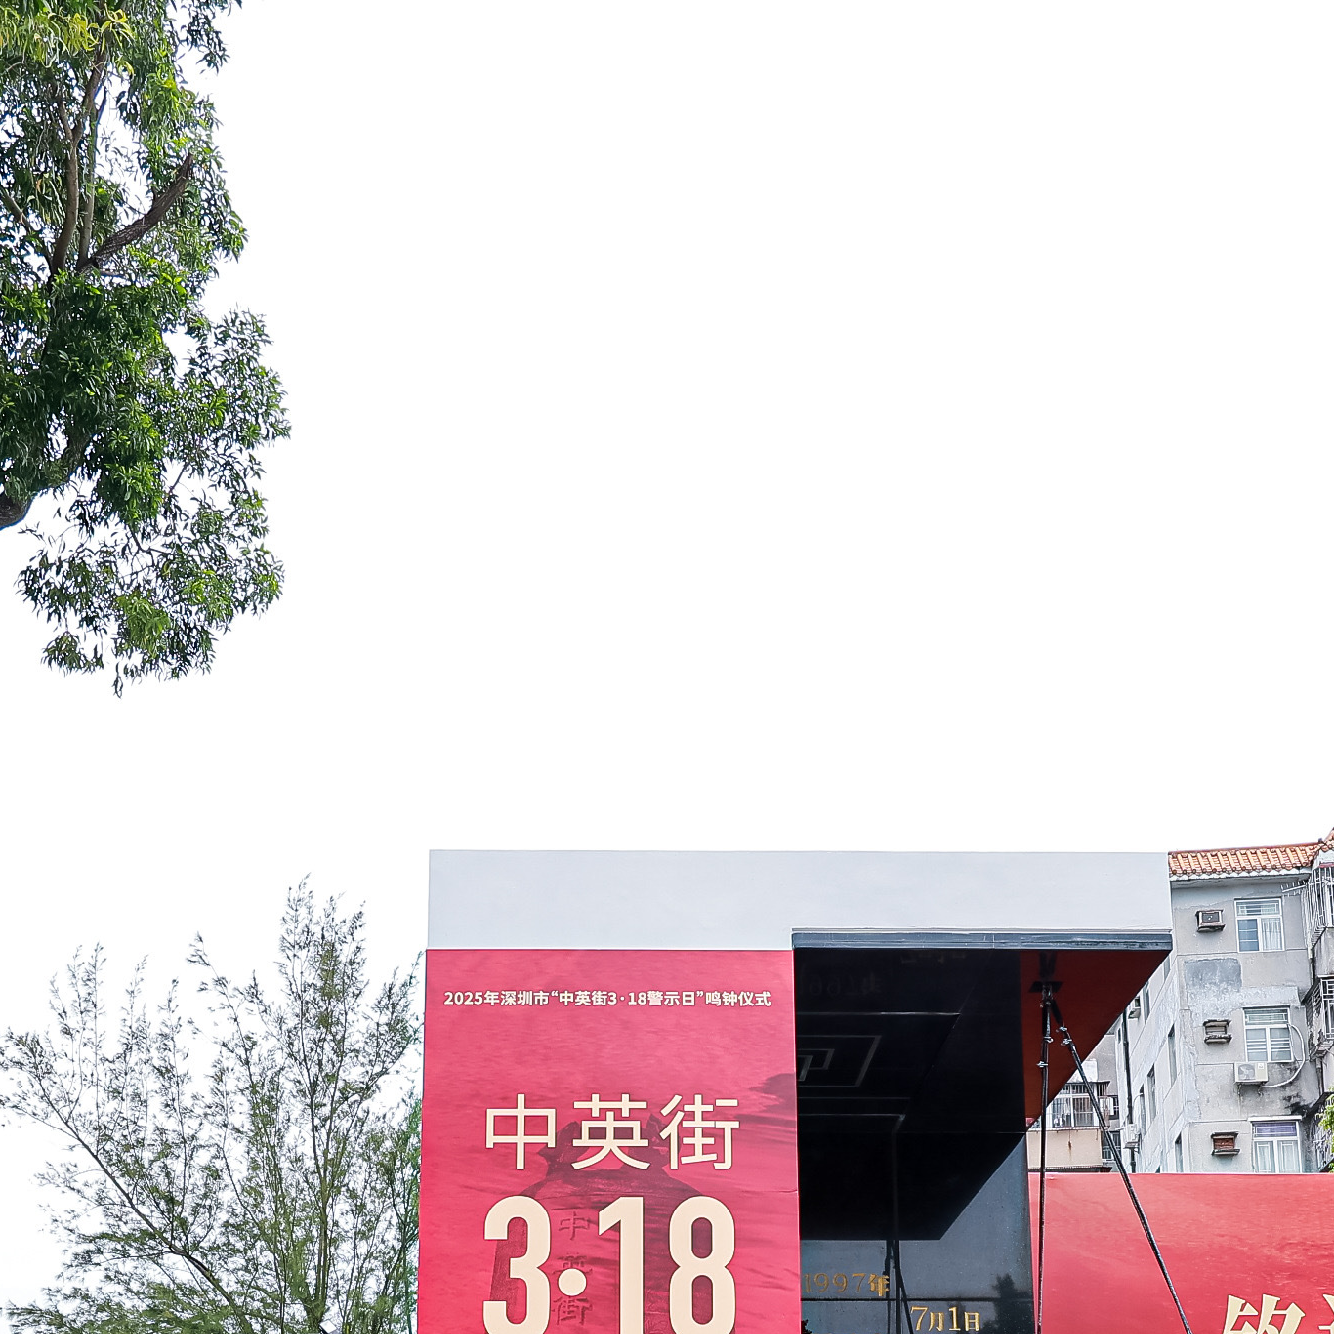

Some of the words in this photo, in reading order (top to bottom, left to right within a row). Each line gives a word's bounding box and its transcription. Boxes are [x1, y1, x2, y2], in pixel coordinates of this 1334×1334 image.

[485, 1093, 739, 1171] 中英街
[804, 1272, 890, 1297] 1997年
[910, 1305, 980, 1332] 7月1日
